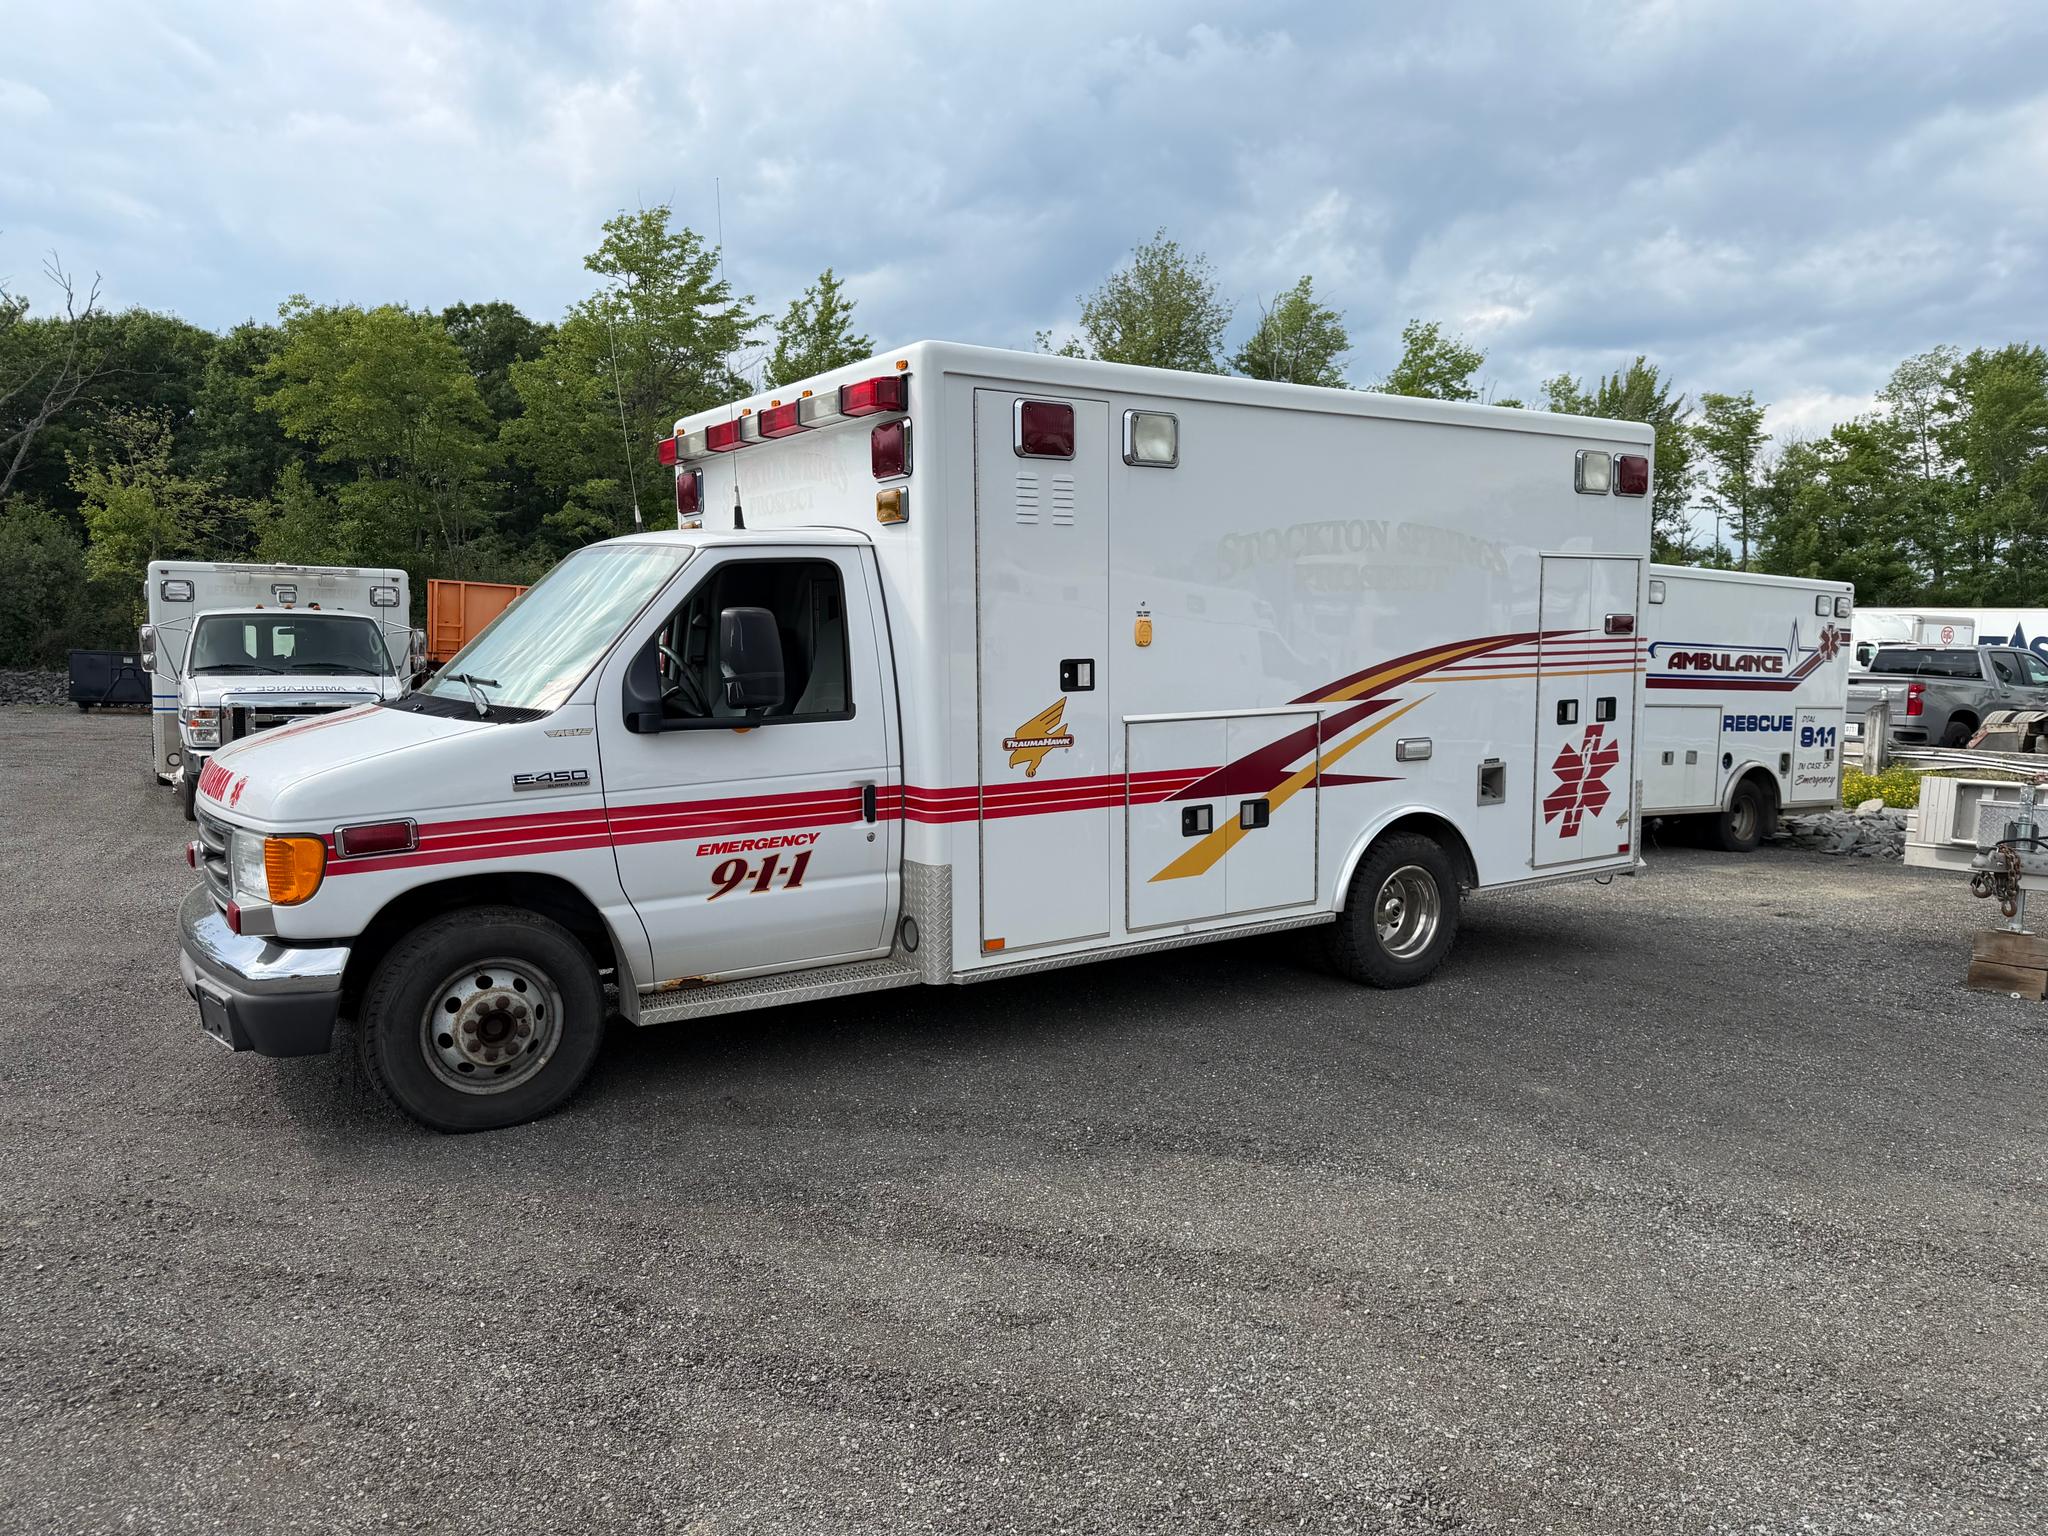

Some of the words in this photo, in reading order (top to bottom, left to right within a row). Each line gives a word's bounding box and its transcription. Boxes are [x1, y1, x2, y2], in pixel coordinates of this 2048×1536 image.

[1668, 652, 1783, 673] AMBULANCE
[1723, 715, 1793, 732] RESCUE
[1795, 775, 1836, 787] Emergency
[696, 832, 821, 857] EMERGENCY
[707, 849, 813, 902] 9-1-1
